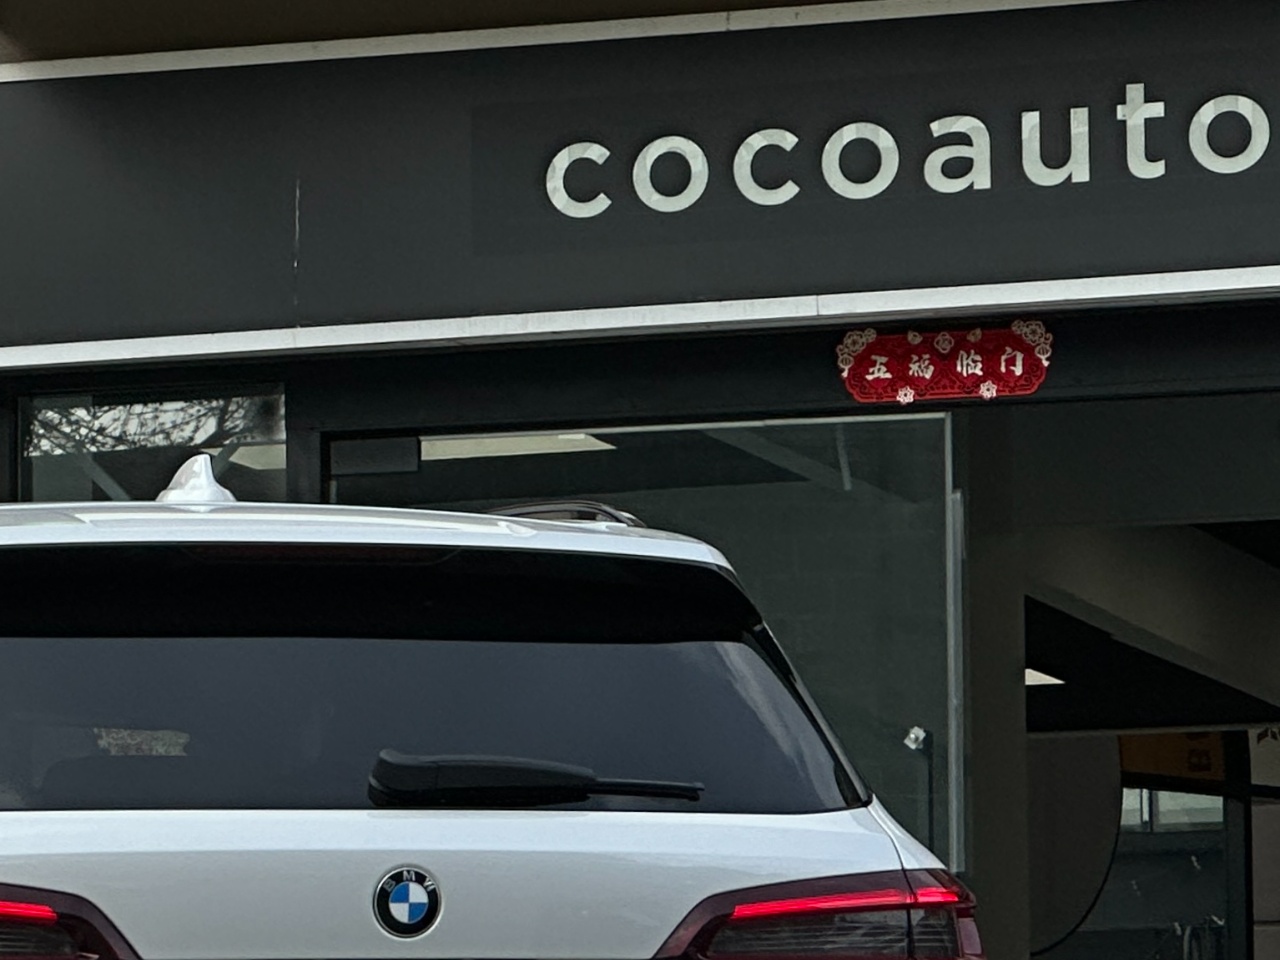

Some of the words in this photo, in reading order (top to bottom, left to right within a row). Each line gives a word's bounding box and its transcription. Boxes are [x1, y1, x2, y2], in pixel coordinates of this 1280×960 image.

[546, 83, 1270, 219] cocoauto
[865, 347, 1025, 381] 五福临门
[382, 869, 436, 892] BMW
